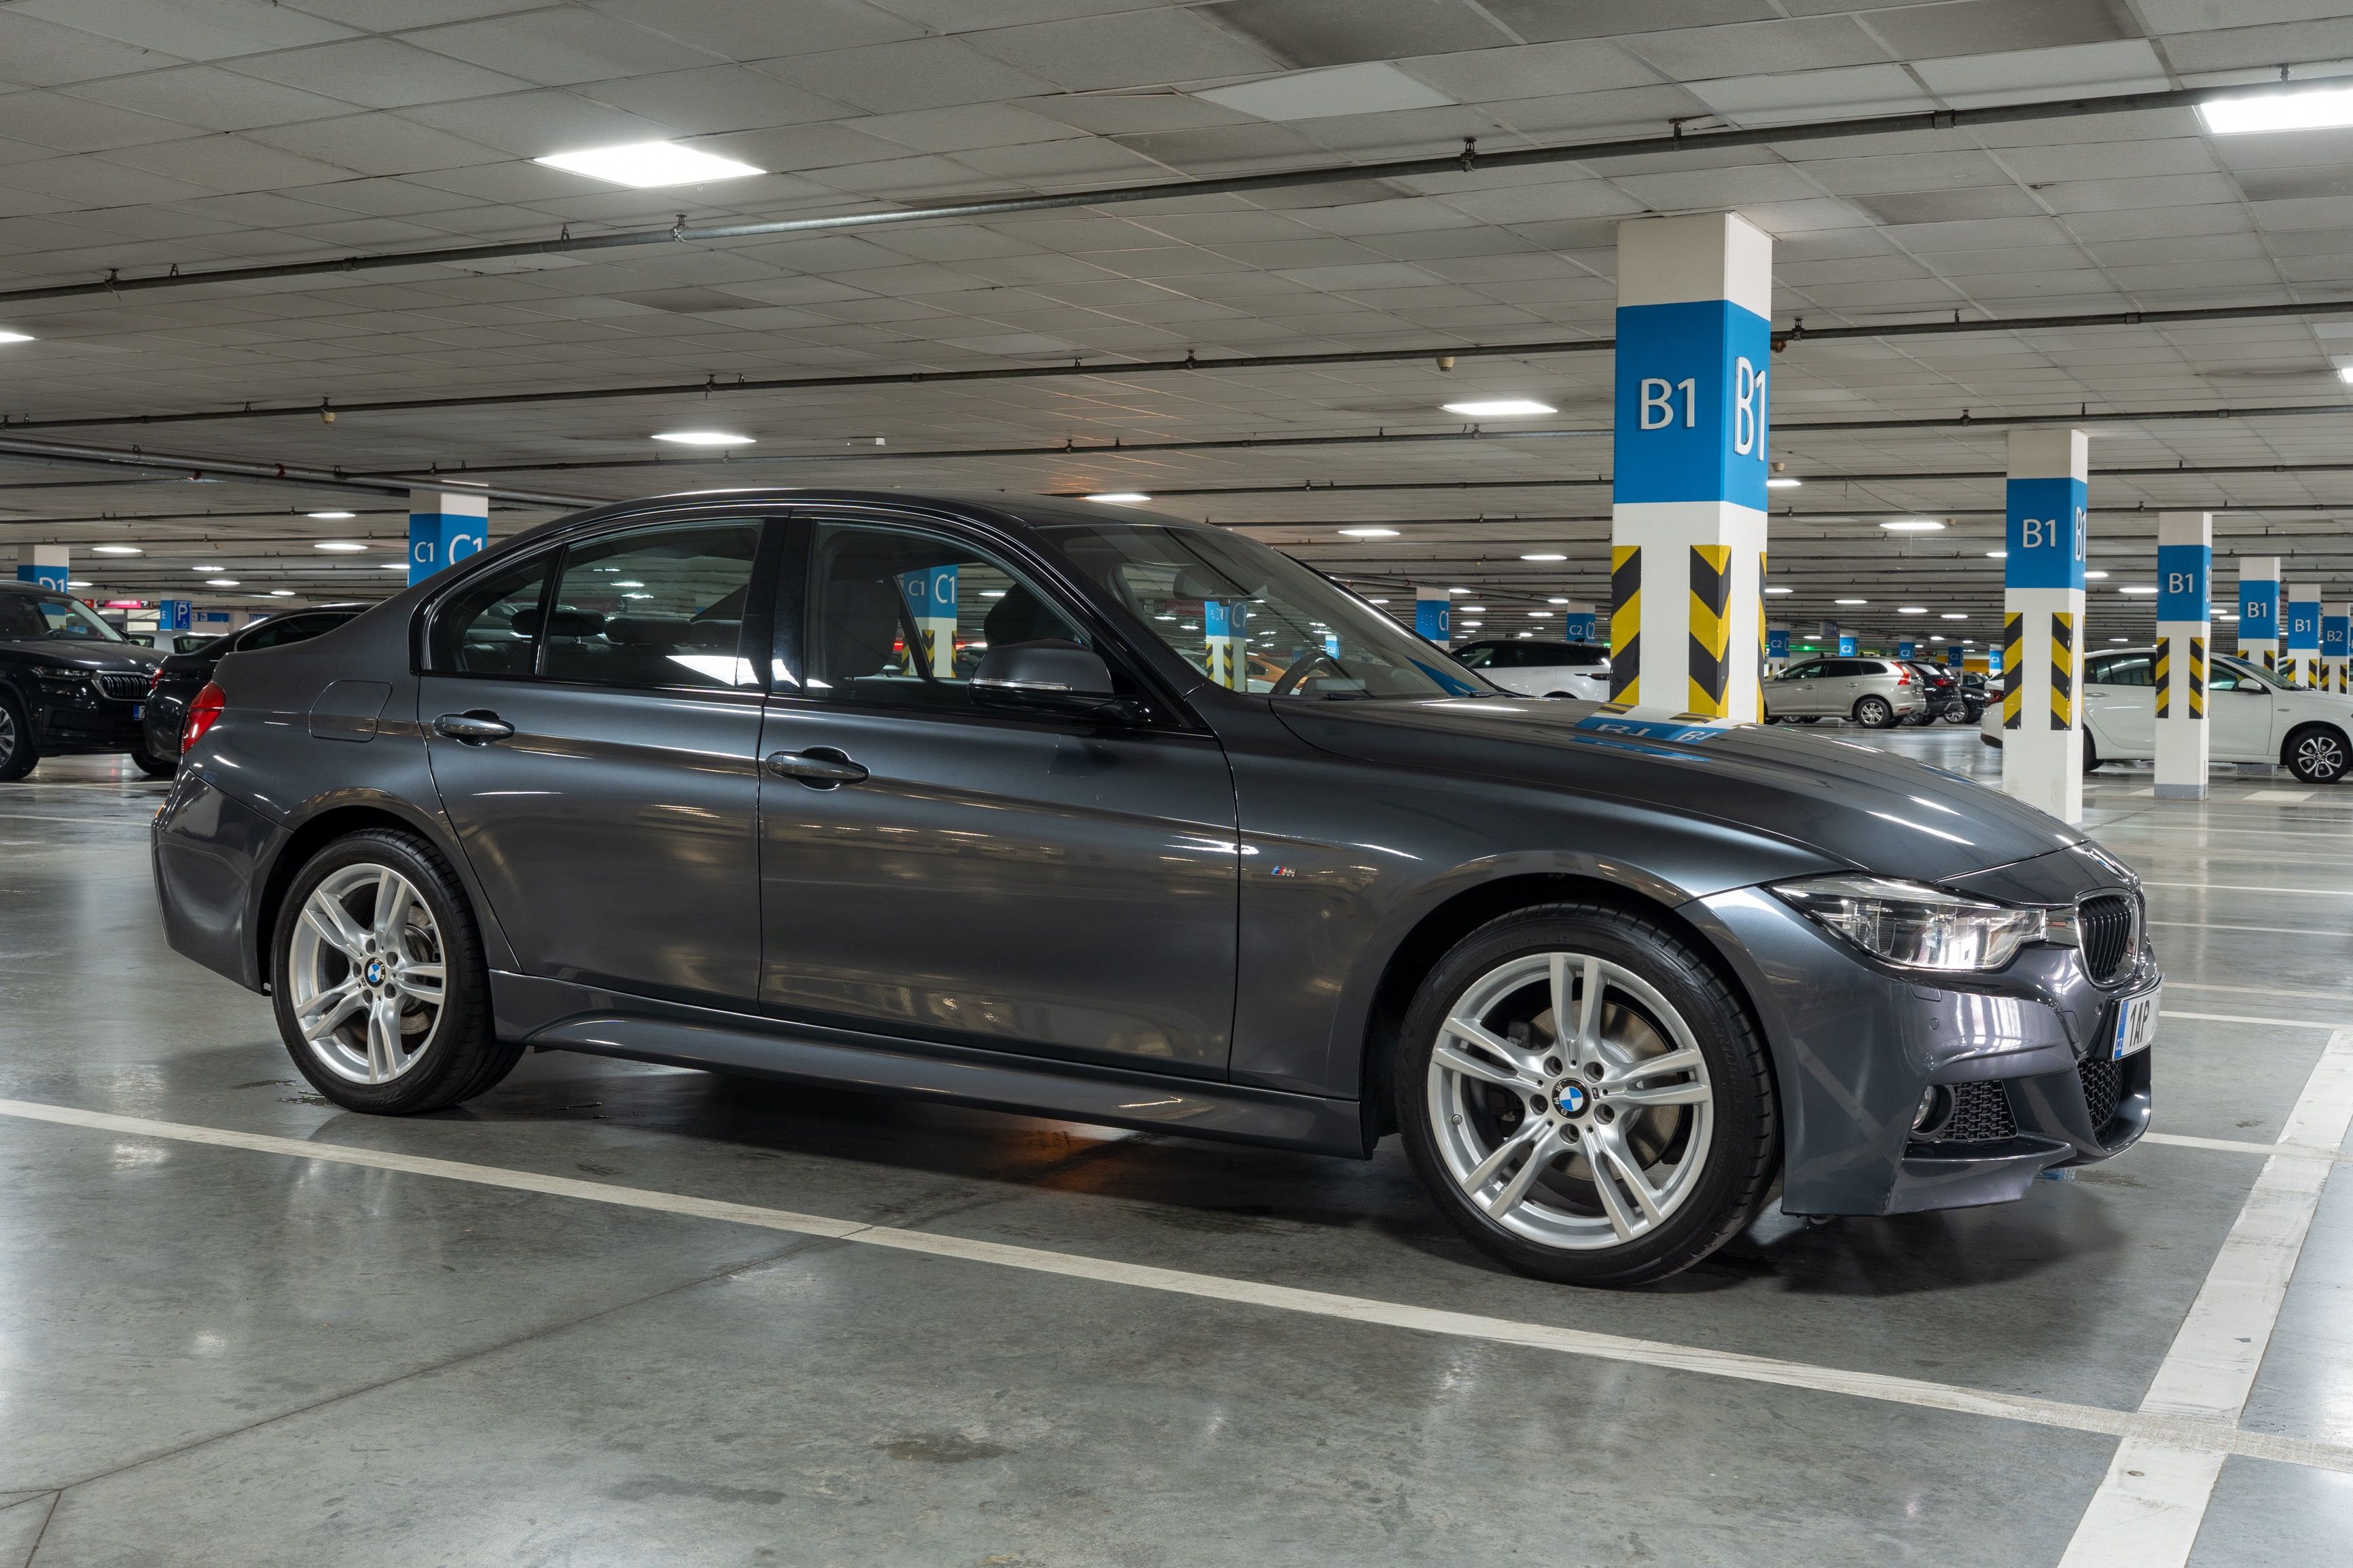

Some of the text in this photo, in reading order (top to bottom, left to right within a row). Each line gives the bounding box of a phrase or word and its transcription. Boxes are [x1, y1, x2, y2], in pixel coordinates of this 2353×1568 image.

[1640, 378, 1695, 430] B1
[1734, 357, 1766, 462] B1
[2023, 519, 2056, 548] B1
[2075, 506, 2086, 562] B1
[414, 541, 434, 563] C1
[908, 580, 924, 596] C1
[935, 574, 955, 604] C1
[2169, 572, 2193, 593] B1
[178, 604, 187, 621] P
[1232, 602, 1246, 627] C1
[2248, 602, 2267, 617] B1
[1439, 610, 1449, 631] C1
[1569, 625, 1583, 635] C2
[2295, 619, 2311, 632] B1
[1771, 640, 1782, 648] C2
[2327, 630, 2343, 641] B2
[2130, 1000, 2149, 1046] 1AP
[2116, 1038, 2123, 1051] CZ
